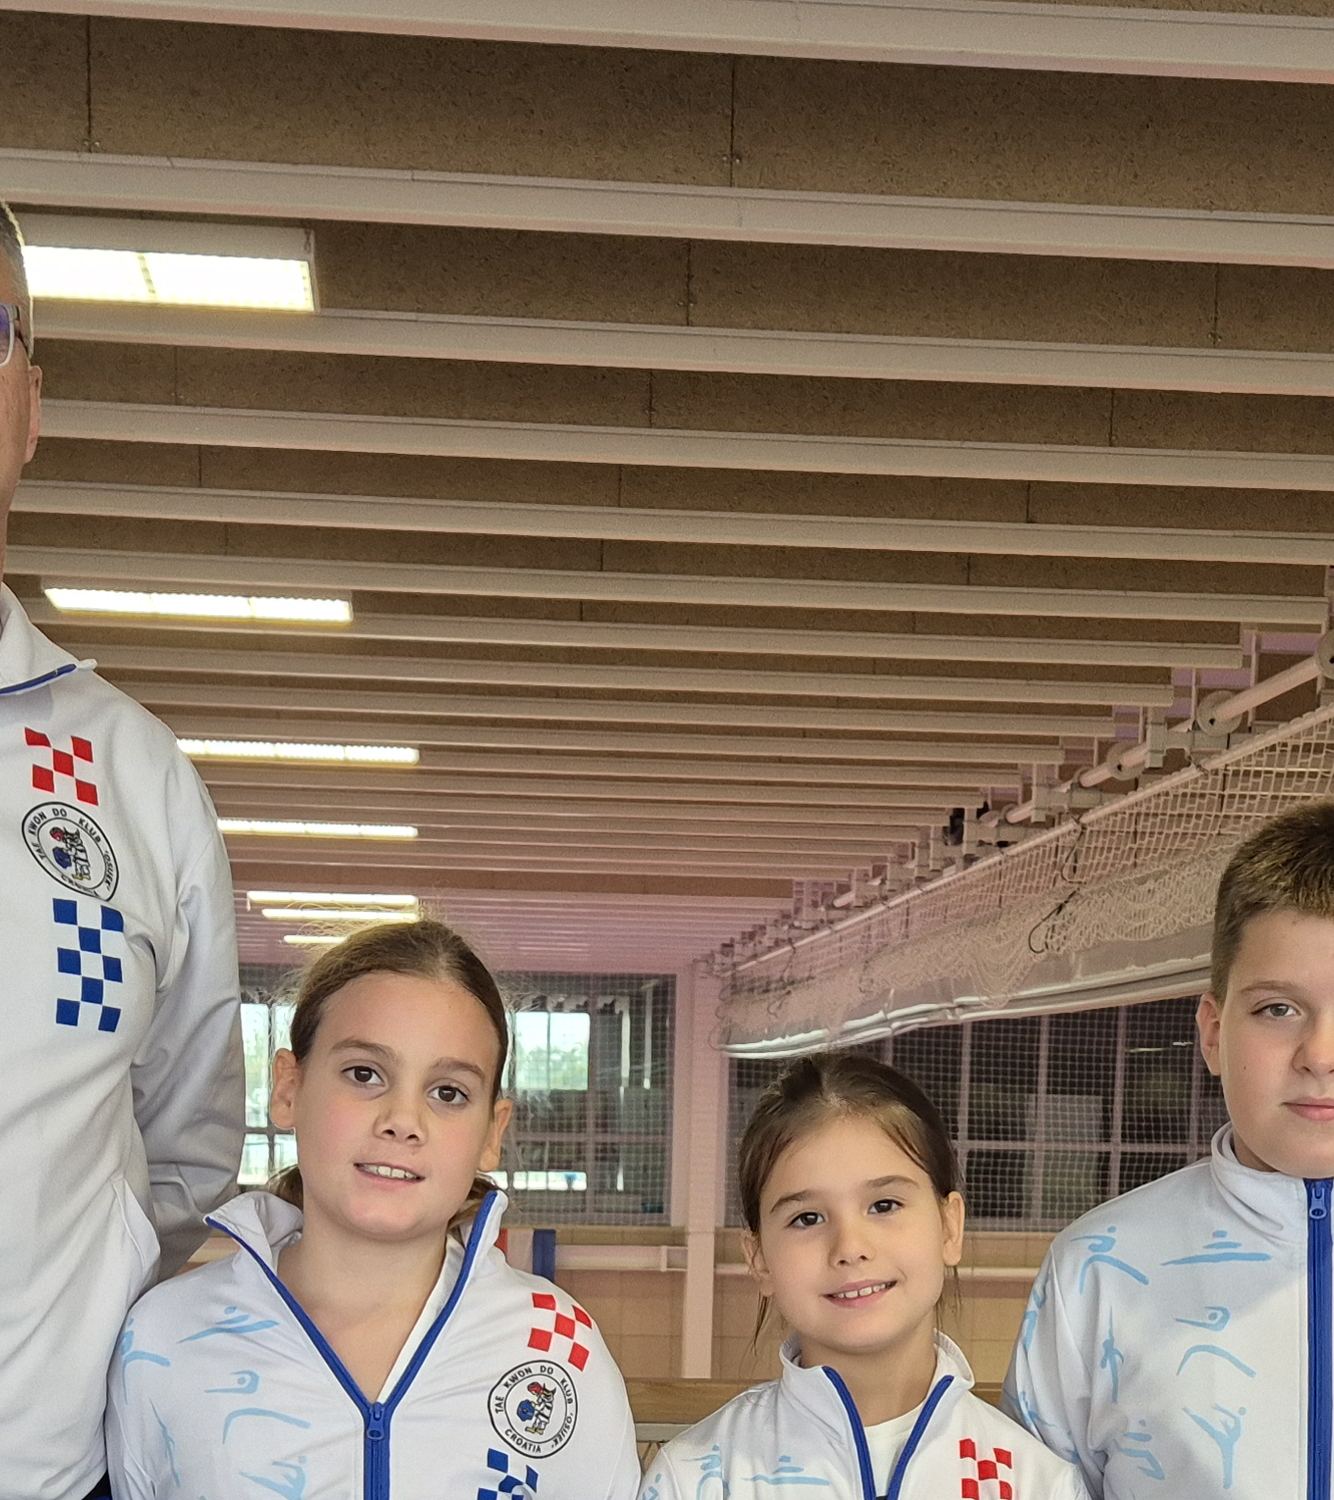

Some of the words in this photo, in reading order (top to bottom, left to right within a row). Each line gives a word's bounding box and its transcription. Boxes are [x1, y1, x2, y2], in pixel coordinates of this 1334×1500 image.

[28, 811, 47, 836] KWON
[52, 808, 67, 817] DO
[78, 817, 101, 843] KLUB
[494, 1396, 505, 1415] TAE
[503, 1367, 533, 1389] KWON
[539, 1365, 555, 1375] DO
[560, 1378, 574, 1405] KLUB
[504, 1428, 542, 1453] CROATIA
